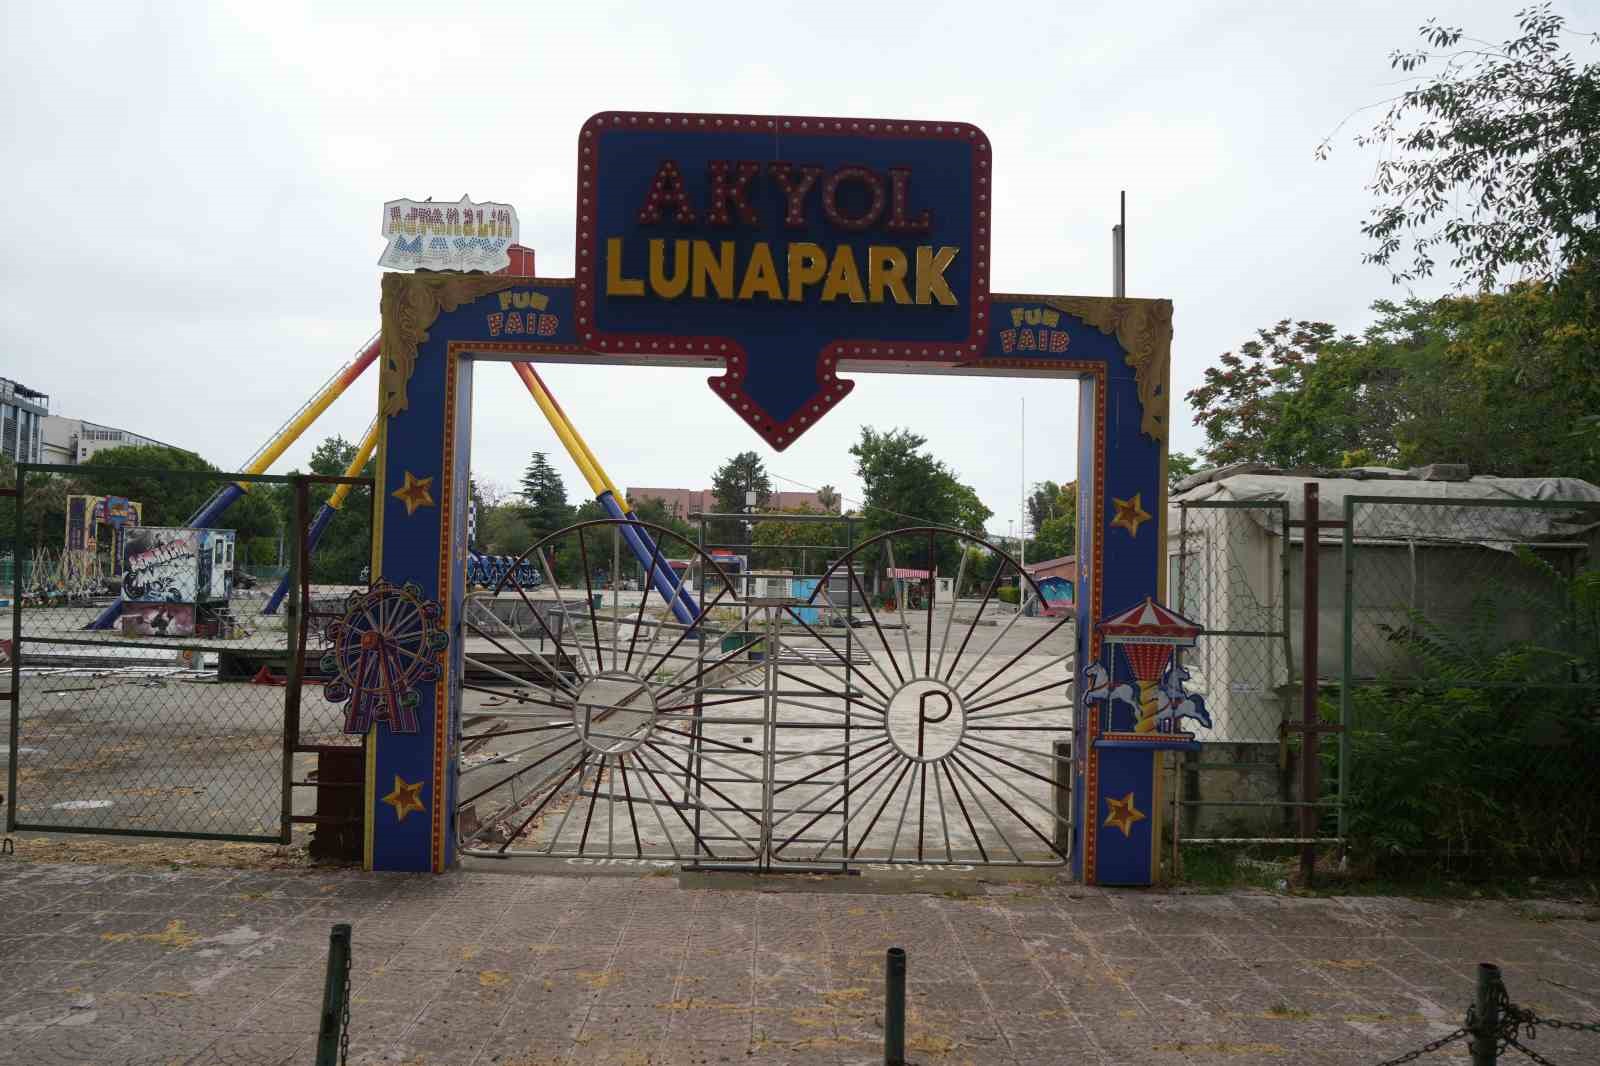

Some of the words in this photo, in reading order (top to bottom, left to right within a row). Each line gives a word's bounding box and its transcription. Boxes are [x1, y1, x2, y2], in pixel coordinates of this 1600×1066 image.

[640, 159, 932, 231] AKYOL
[605, 237, 961, 306] LUNAPARK
[498, 291, 550, 312] FUN
[488, 313, 560, 337] FAIR
[1010, 308, 1060, 328] FUN
[1000, 328, 1071, 353] FAIR
